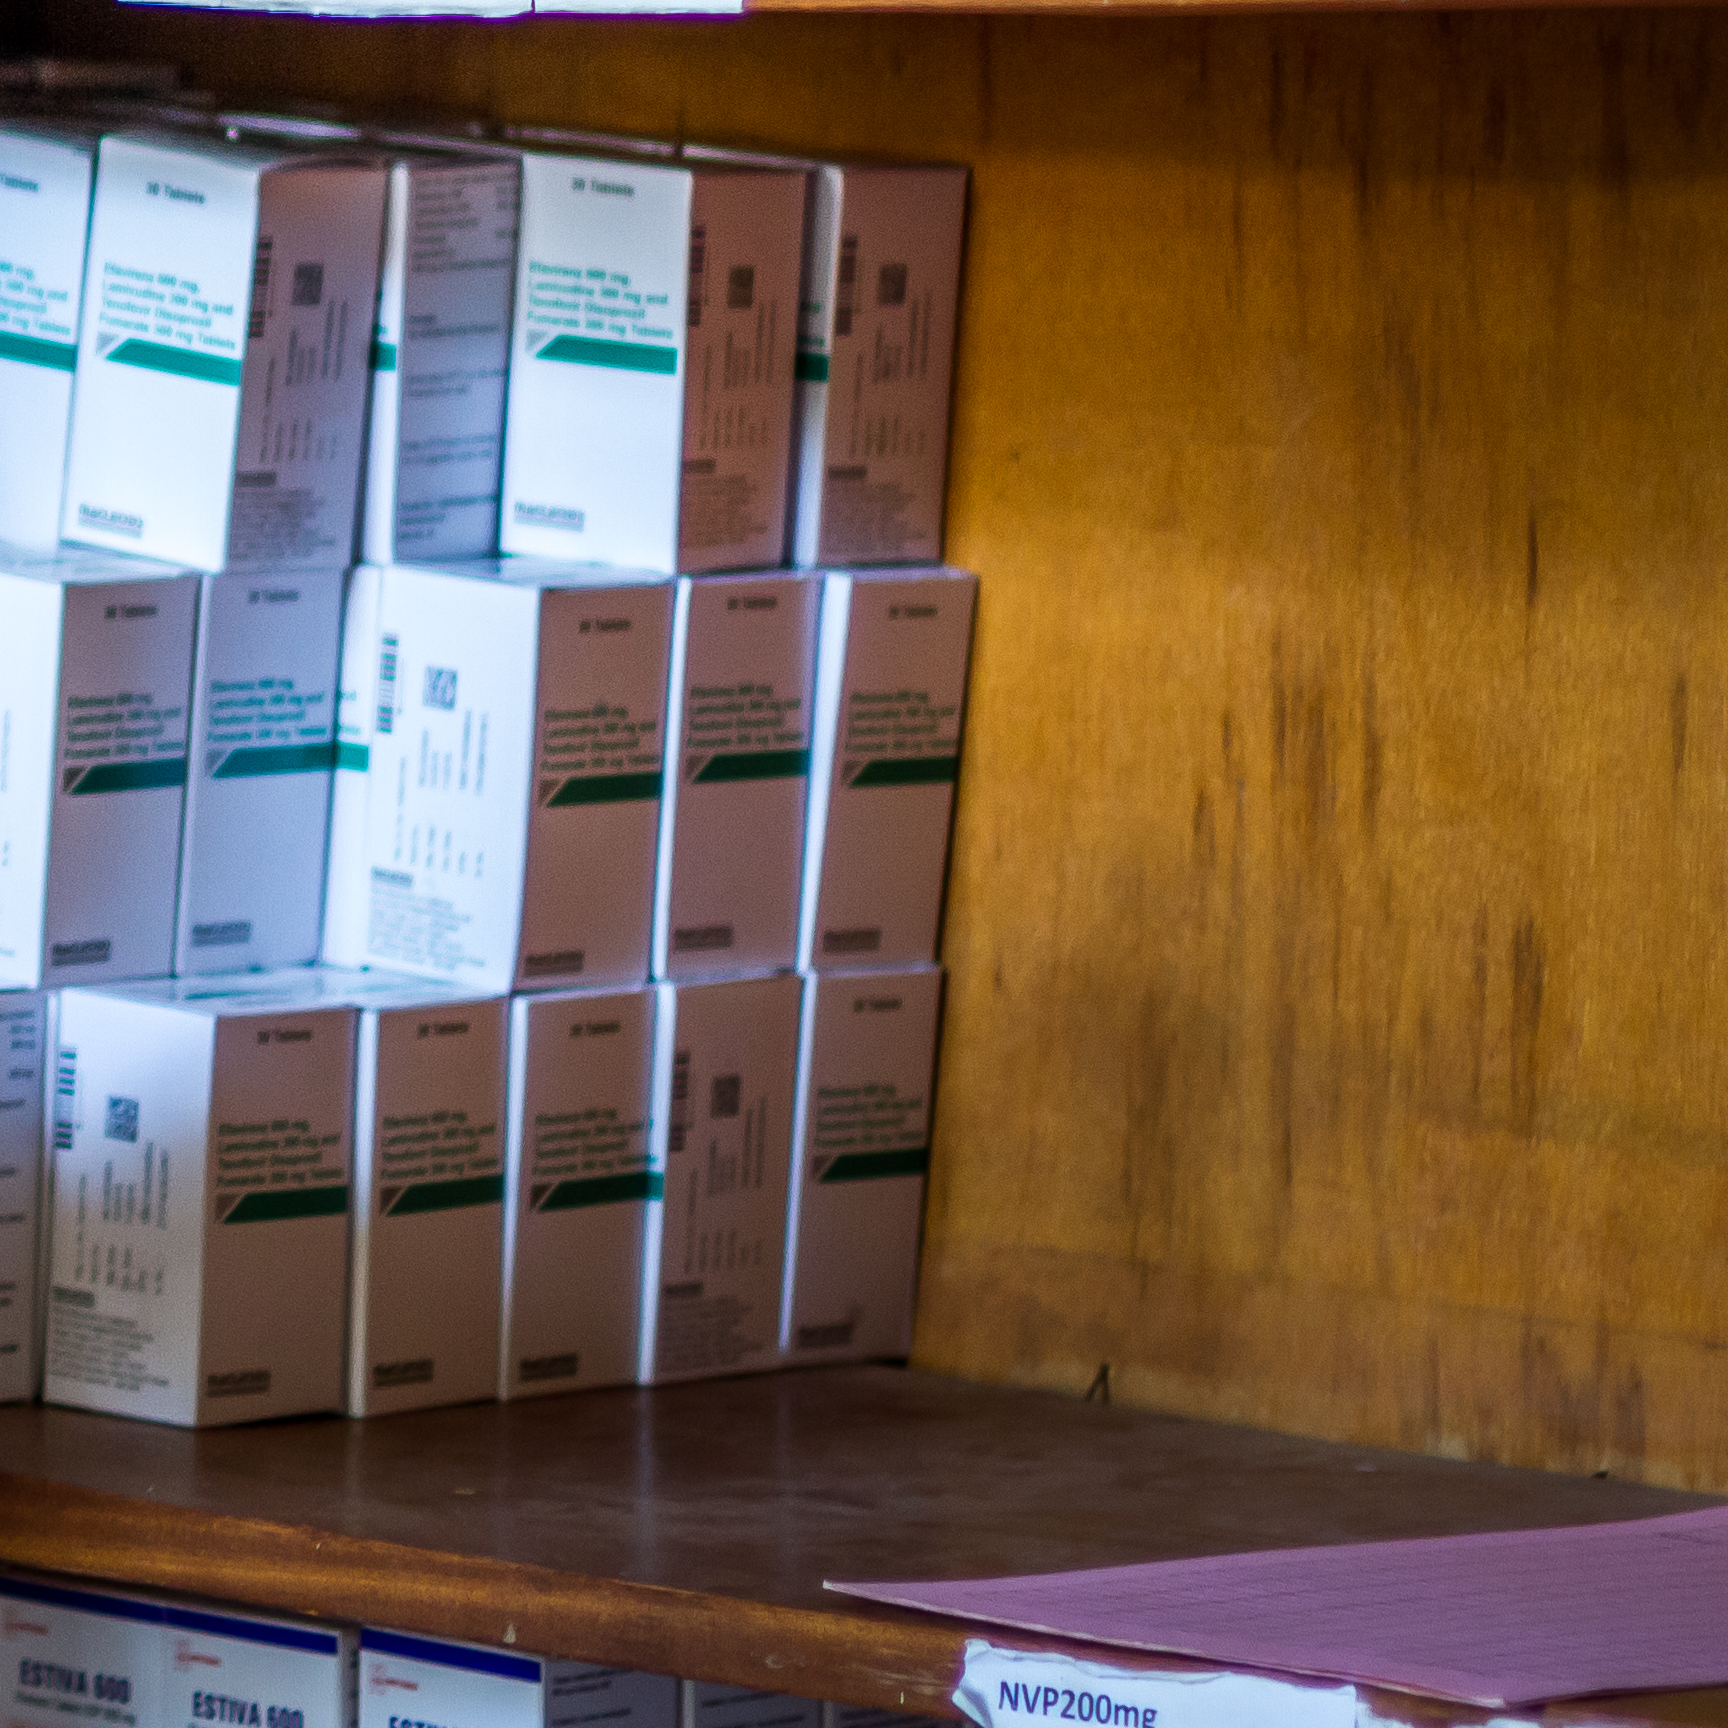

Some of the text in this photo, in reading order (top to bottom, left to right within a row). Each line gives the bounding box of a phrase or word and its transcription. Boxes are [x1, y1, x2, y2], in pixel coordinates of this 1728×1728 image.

[163, 185, 205, 205] Tablets
[591, 178, 634, 197] Tablets
[192, 300, 208, 313] mg
[212, 304, 233, 316] and
[199, 331, 235, 350] Tablets
[19, 1659, 131, 1704] ESTIVA 600
[192, 1691, 303, 1728] ESTIVA 600
[999, 1681, 1157, 1728] NVP200mg
